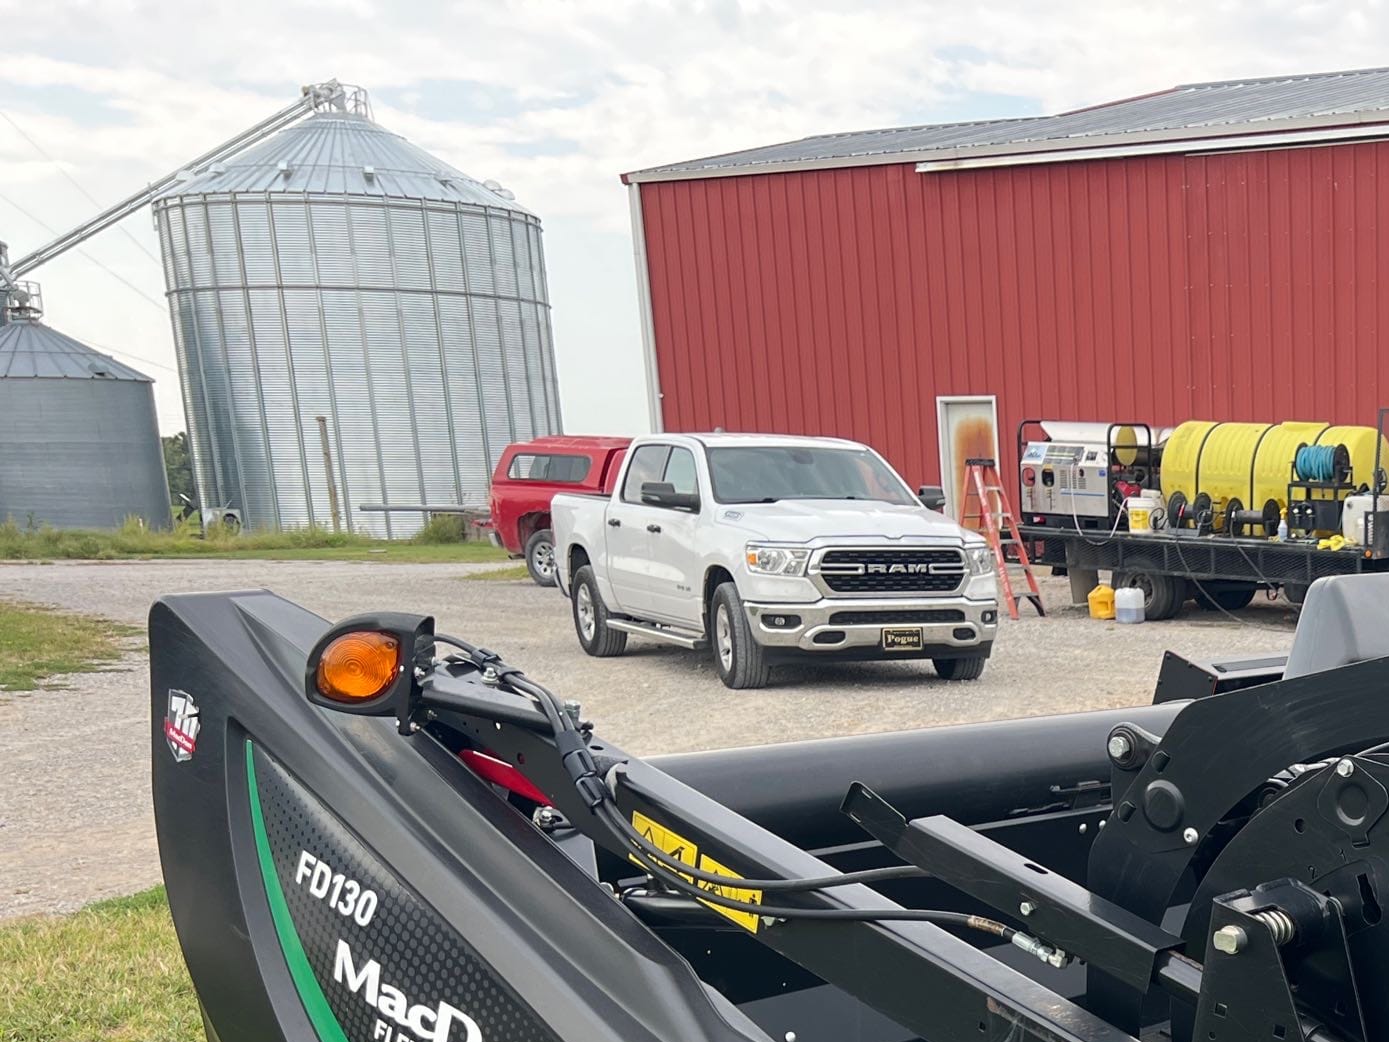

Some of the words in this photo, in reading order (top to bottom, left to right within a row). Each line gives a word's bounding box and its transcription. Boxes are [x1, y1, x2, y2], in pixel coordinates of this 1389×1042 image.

[867, 563, 927, 574] RAM
[886, 634, 919, 645] Pogue
[295, 850, 378, 927] FD130
